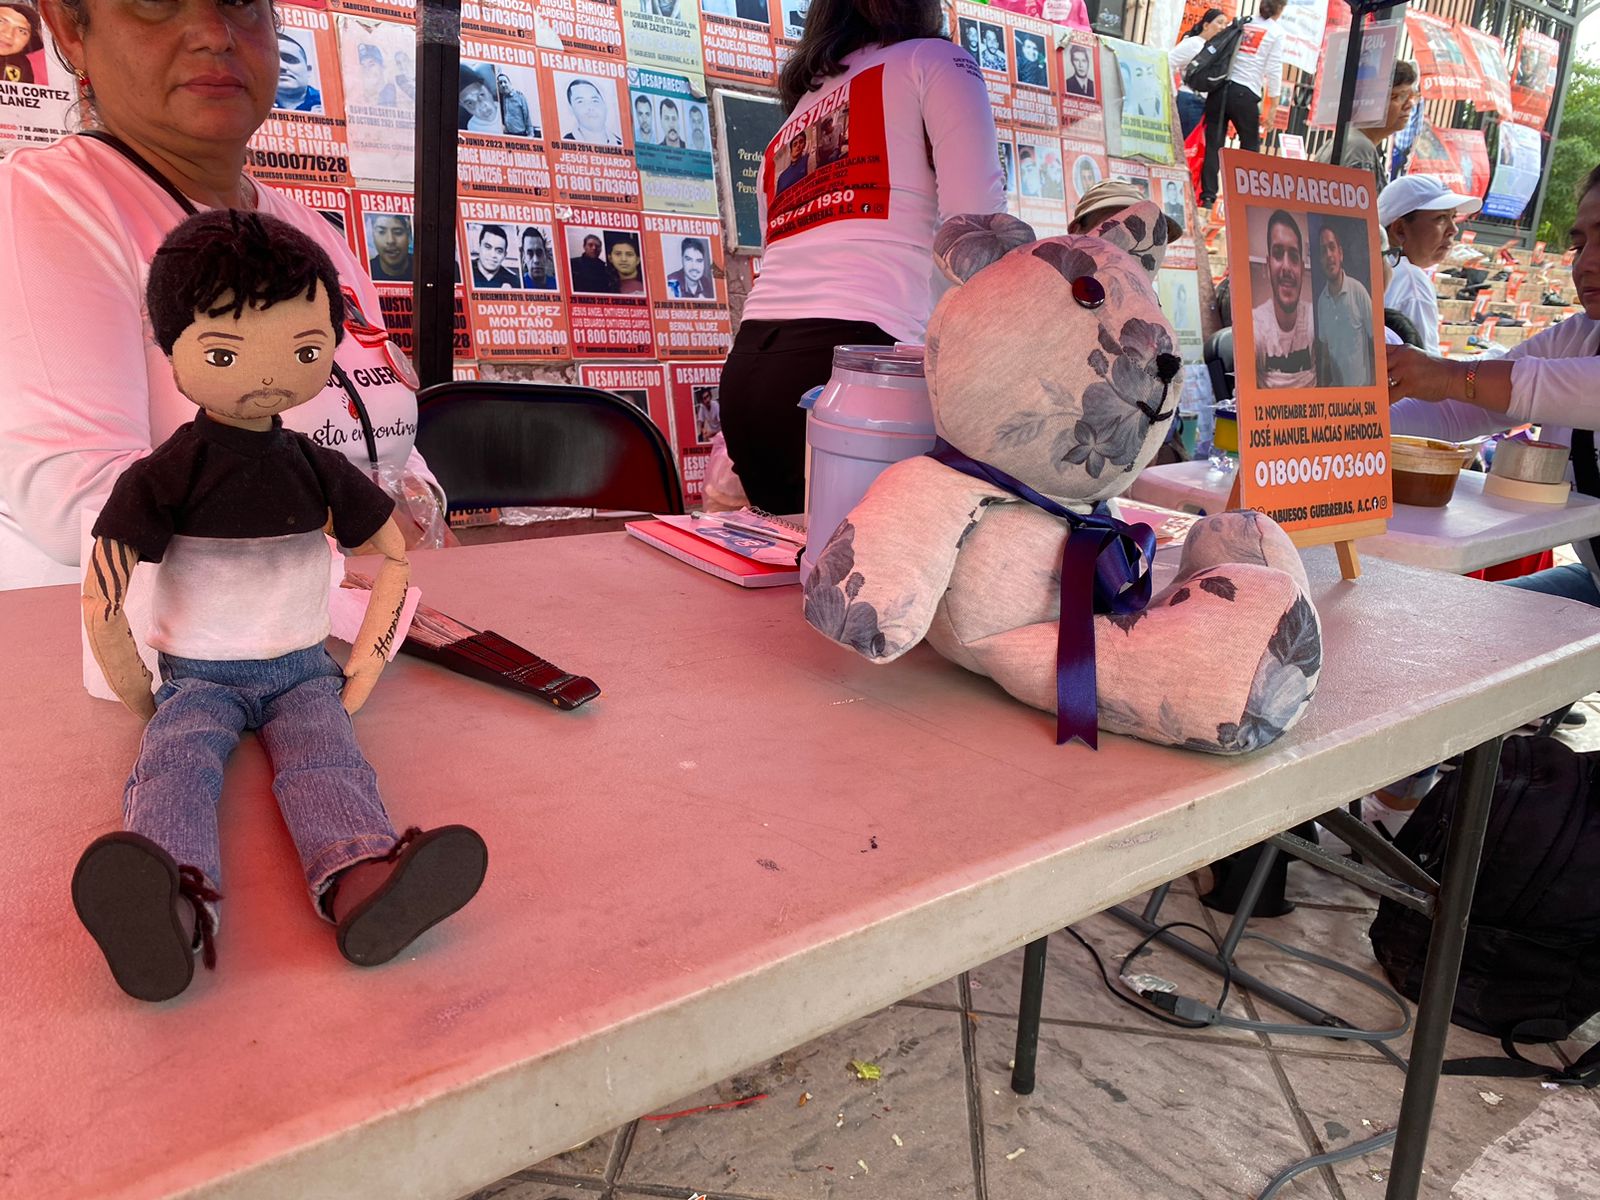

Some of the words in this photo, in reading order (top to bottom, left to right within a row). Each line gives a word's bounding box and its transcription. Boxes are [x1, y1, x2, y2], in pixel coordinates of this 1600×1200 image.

[576, 1, 616, 20] ENRIQUE
[575, 23, 623, 47] 6703600
[632, 19, 649, 31] OMAR
[649, 22, 674, 35] ZAZUETA
[705, 22, 738, 40] ALFONSO
[703, 34, 747, 54] PALAZUELOS
[541, 52, 626, 79] DESAPARECIDO
[705, 48, 717, 64] 01
[717, 50, 735, 67] 800
[736, 54, 775, 74] 6703600
[22, 86, 71, 102] CORTEZ
[307, 117, 334, 126] PERICOS
[774, 80, 851, 153] JUSTICIA
[32, 126, 49, 134] JUNIO
[286, 122, 333, 141] CESAR
[33, 136, 49, 144] JUNIO
[297, 139, 349, 158] RIVERA
[560, 152, 589, 165] JESÚS
[590, 156, 632, 169] EDUARDO
[555, 162, 602, 177] PEÑUELAS
[555, 174, 569, 190] 01
[569, 175, 593, 192] 800
[593, 178, 640, 196] 6703600
[1234, 167, 1370, 210] DESAPARECIDO
[460, 202, 552, 223] DESAPARECIDO
[644, 217, 719, 236] DESAPARECIDO
[477, 303, 517, 316] DAVID
[520, 302, 561, 317] LÓPEZ
[655, 309, 670, 320] LUIS
[670, 309, 699, 320] ENRIQUE
[488, 315, 554, 328] MONTAÑO
[583, 318, 606, 328] EDUARDO
[668, 321, 695, 332] BERNAL
[695, 321, 719, 332] VALDEZ
[476, 328, 491, 345] 01
[491, 328, 516, 345] 800
[517, 329, 568, 345] 6703600
[573, 328, 586, 344] 01
[587, 329, 607, 344] 800
[608, 329, 652, 345] 6703600
[657, 332, 670, 347] 01
[670, 332, 690, 347] 800
[690, 332, 731, 347] 6703600
[587, 370, 661, 387] DESAPARECIDO
[1254, 405, 1264, 421] 12
[1264, 402, 1308, 420] NOVIEMBRE
[1308, 402, 1328, 420] 2017,
[1328, 399, 1363, 418] CULIACÁN,
[1364, 401, 1377, 416] SIN.
[1249, 423, 1272, 448] JOSÉ
[1273, 428, 1310, 447] MANUEL
[1344, 422, 1384, 442] MENDOZA
[1255, 450, 1387, 487] 018006703600
[1357, 499, 1372, 513] A.C.
